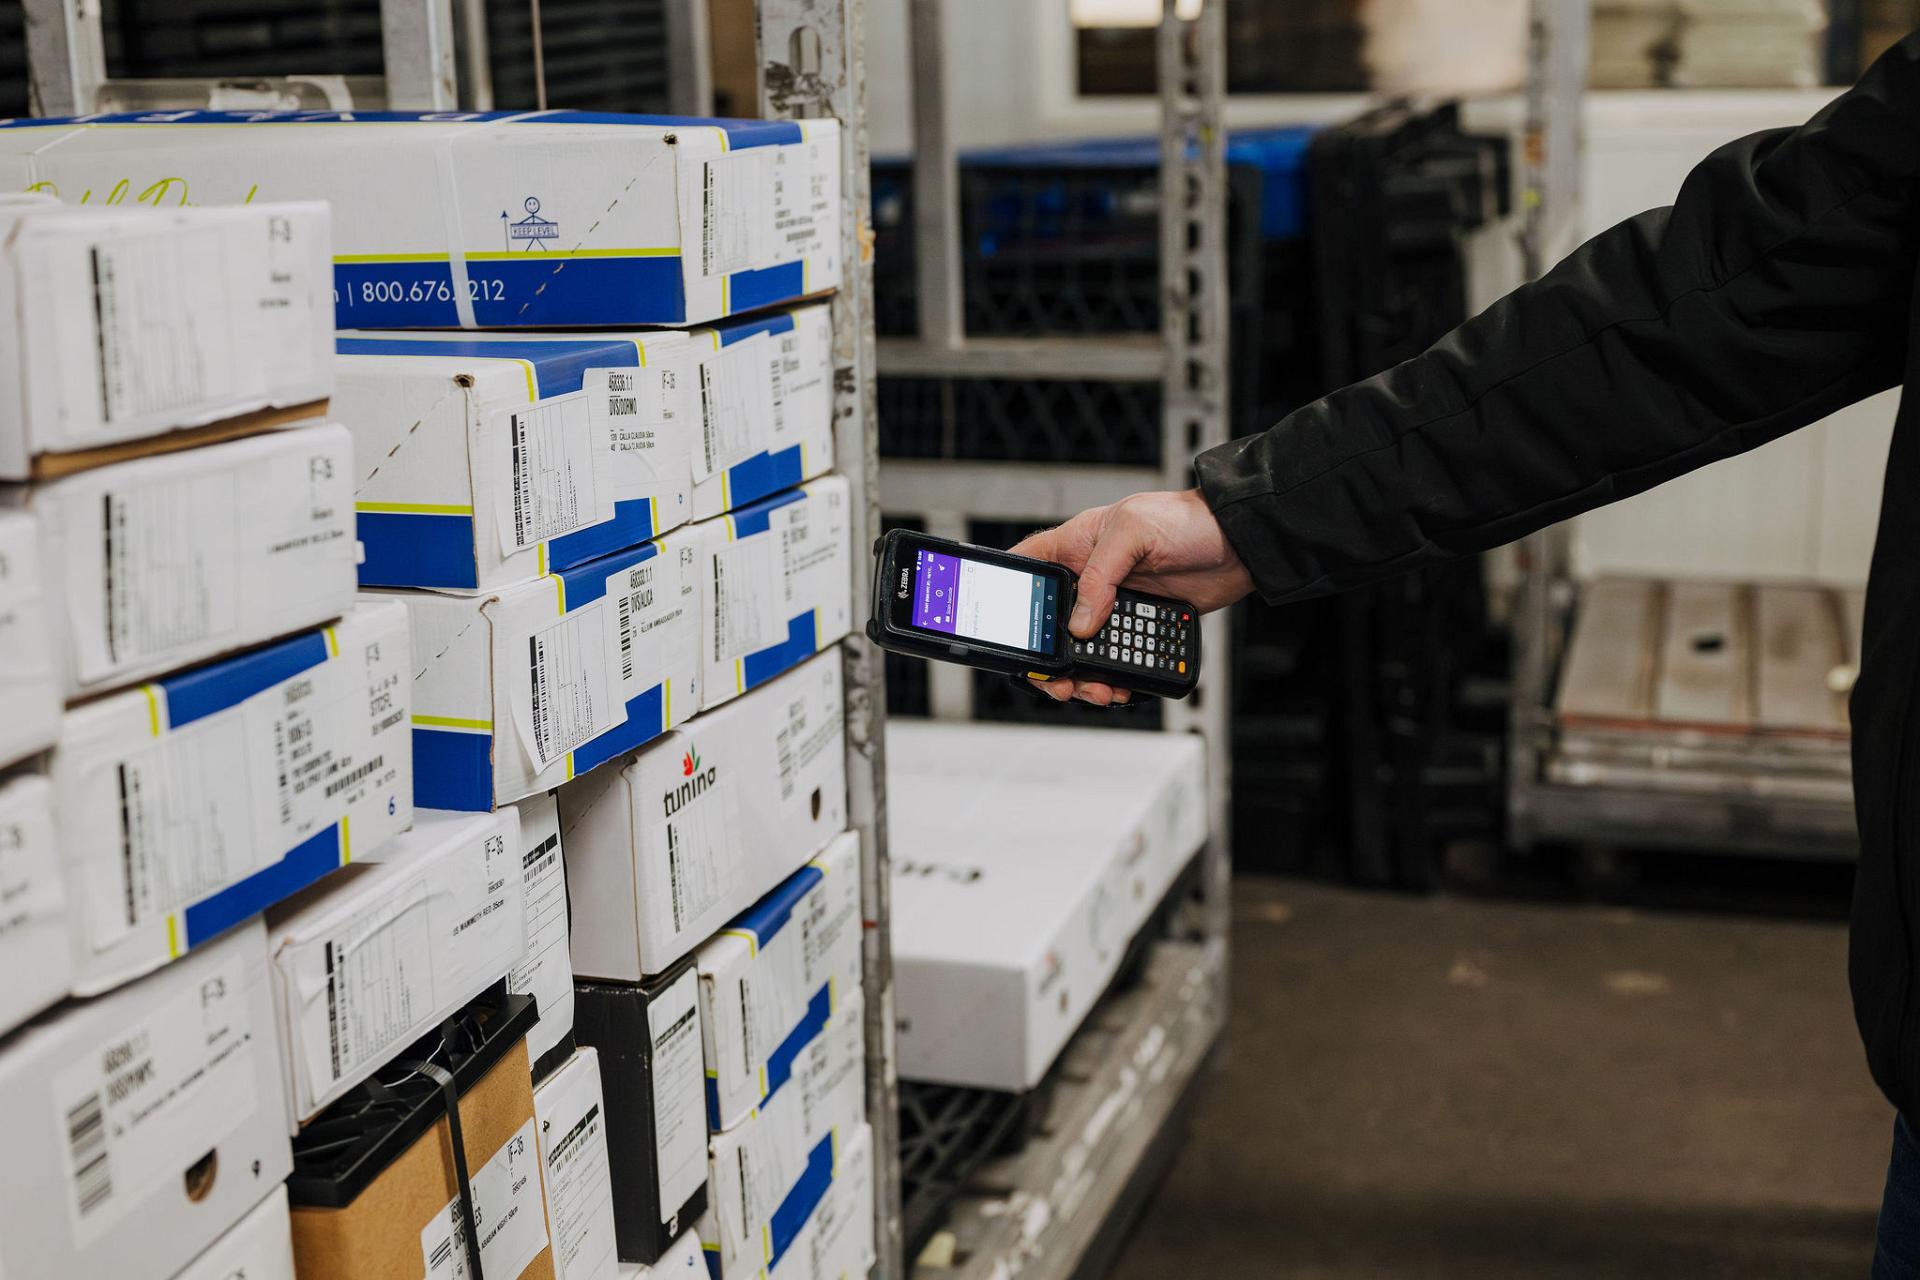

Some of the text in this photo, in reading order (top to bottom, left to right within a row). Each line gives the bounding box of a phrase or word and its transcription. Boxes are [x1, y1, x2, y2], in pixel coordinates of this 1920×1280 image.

[513, 226, 556, 236] KEEP LEVEL
[361, 279, 505, 303] 800.676.212
[901, 567, 909, 589] ZEBRA
[388, 796, 396, 816] 6
